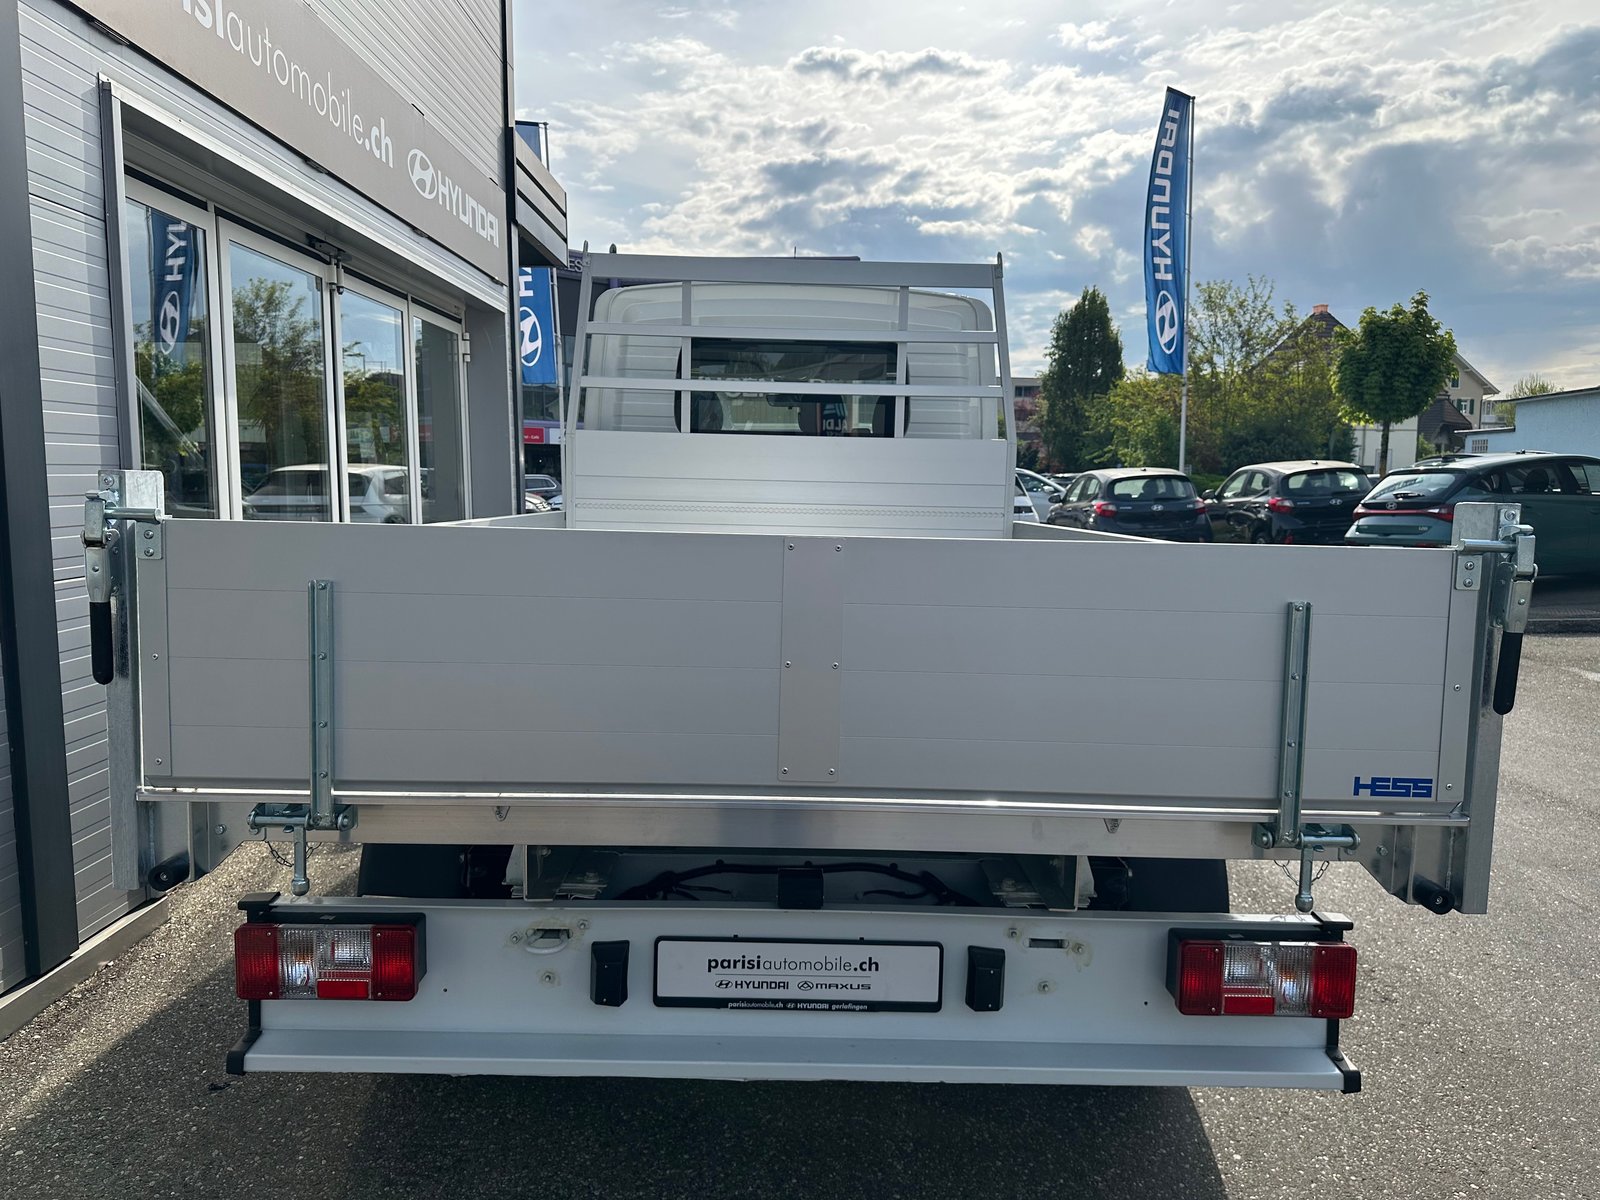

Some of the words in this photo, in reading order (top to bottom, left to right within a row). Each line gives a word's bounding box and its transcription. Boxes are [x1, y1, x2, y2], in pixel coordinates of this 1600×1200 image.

[437, 169, 499, 249] HYUNDAI
[1353, 776, 1434, 798] HESS
[707, 954, 880, 973] parisiautomobile.ch
[734, 980, 789, 990] HYUNDAI
[815, 982, 872, 990] MAXUS
